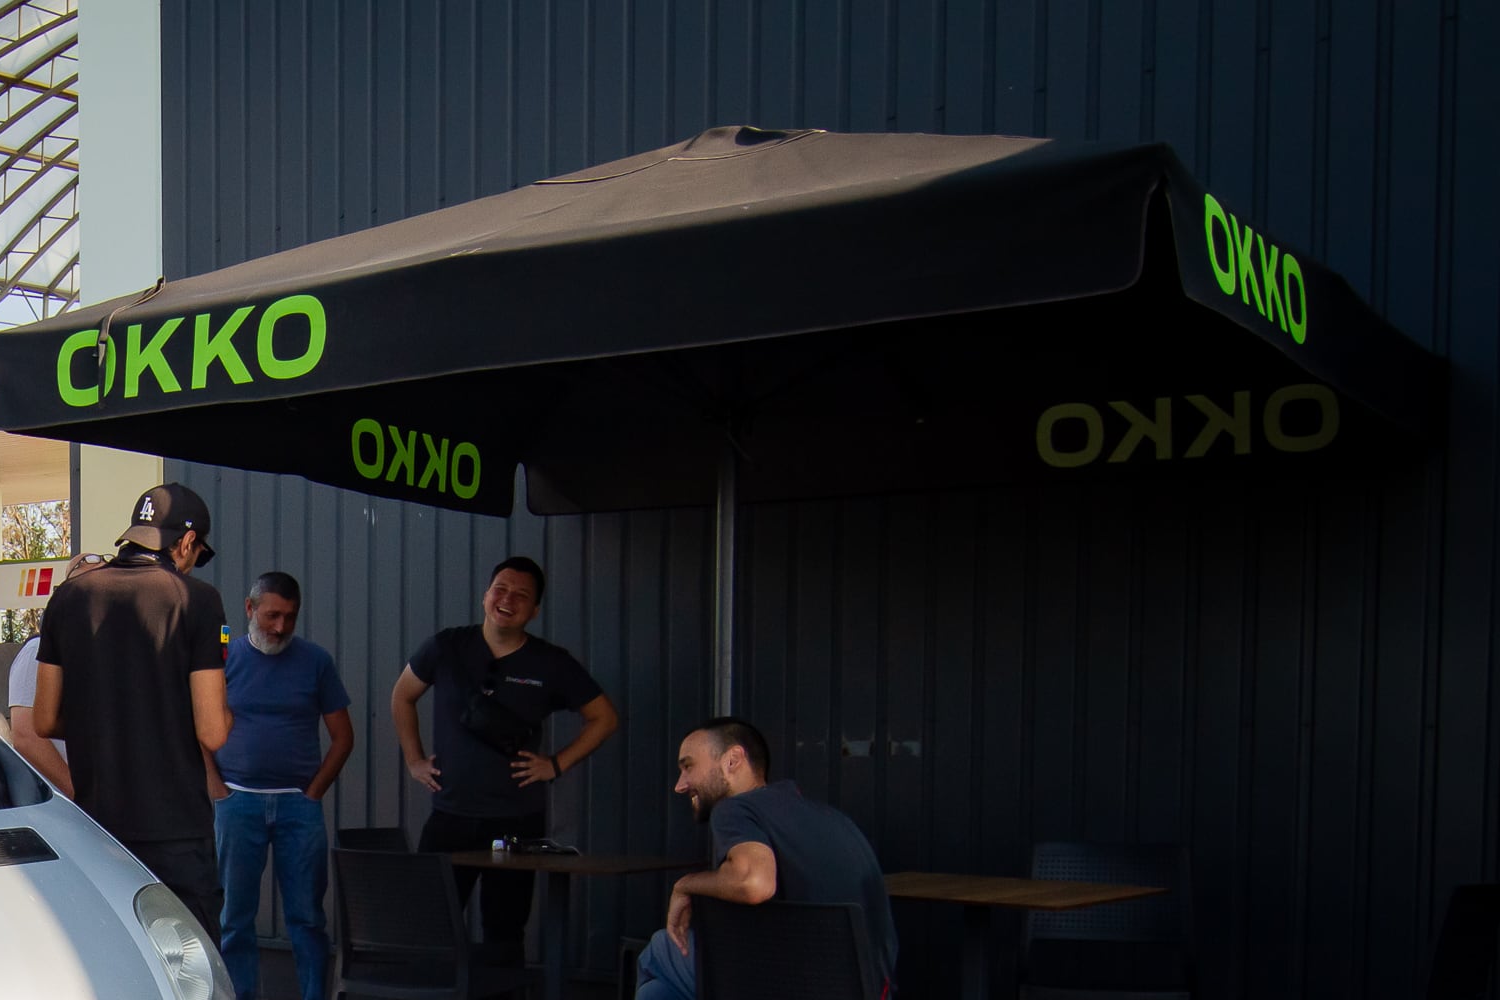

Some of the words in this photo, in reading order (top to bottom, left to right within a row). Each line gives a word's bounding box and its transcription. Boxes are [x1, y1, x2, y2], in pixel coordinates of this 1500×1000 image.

[1204, 193, 1308, 345] OKKO
[56, 293, 328, 408] OKKO
[139, 496, 155, 522] LA
